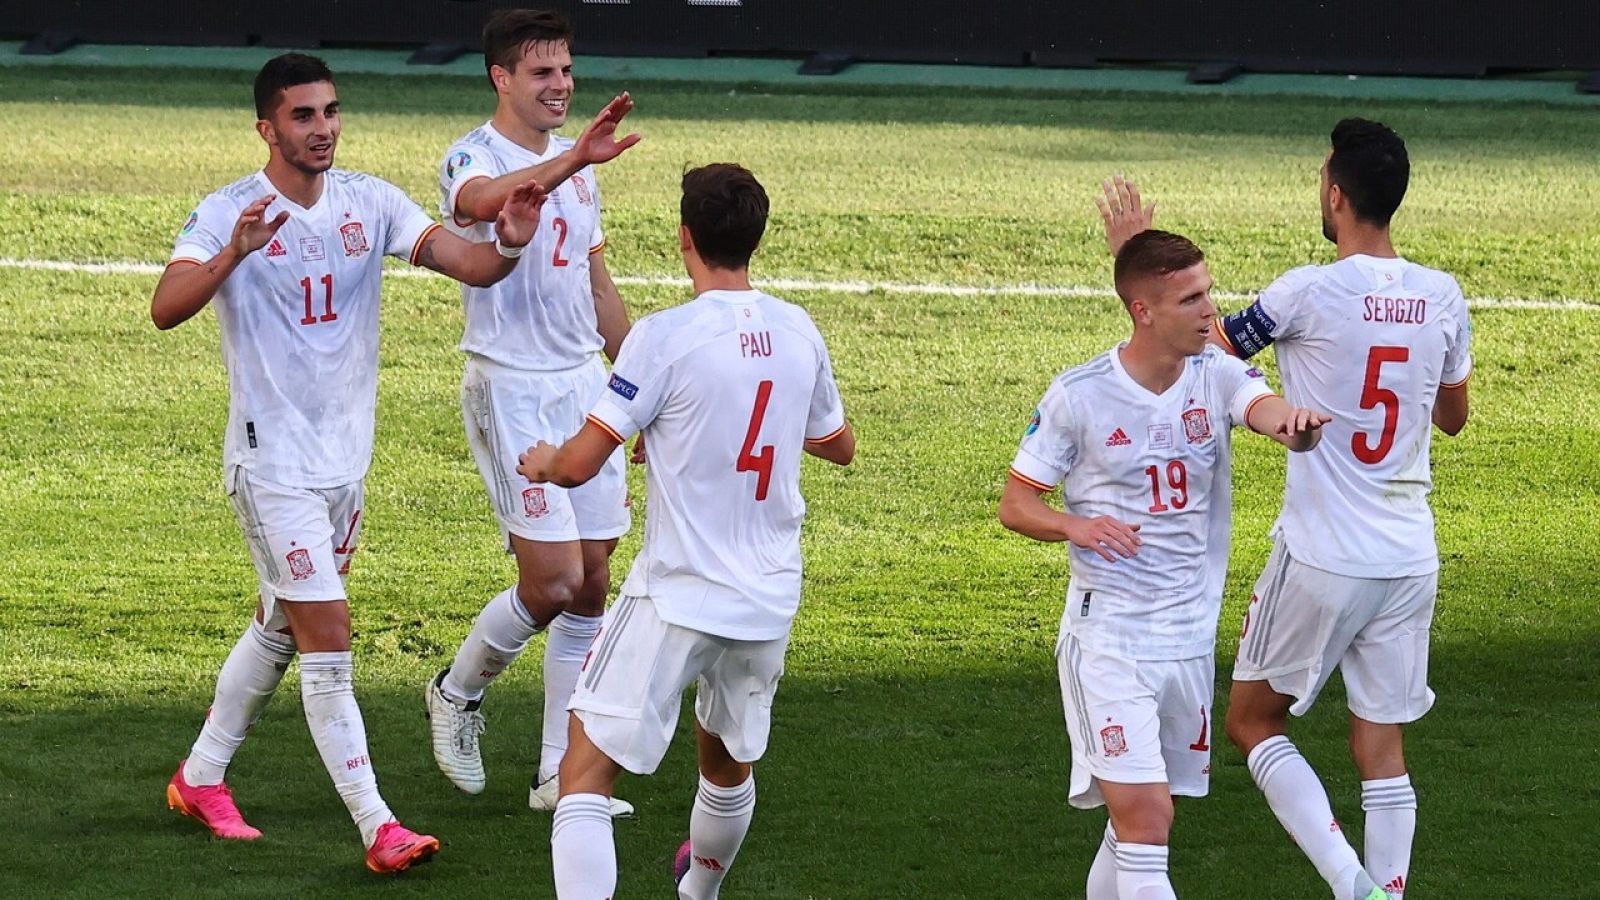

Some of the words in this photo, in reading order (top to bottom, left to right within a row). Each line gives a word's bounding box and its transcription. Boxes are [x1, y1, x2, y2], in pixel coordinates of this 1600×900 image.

[552, 216, 569, 267] 2
[300, 273, 338, 326] 11
[1363, 295, 1426, 325] SERGIO
[739, 331, 772, 358] PAU
[1351, 345, 1410, 465] 5
[736, 379, 775, 501] 4
[1105, 438, 1132, 447] adidas
[1145, 459, 1189, 513] 19
